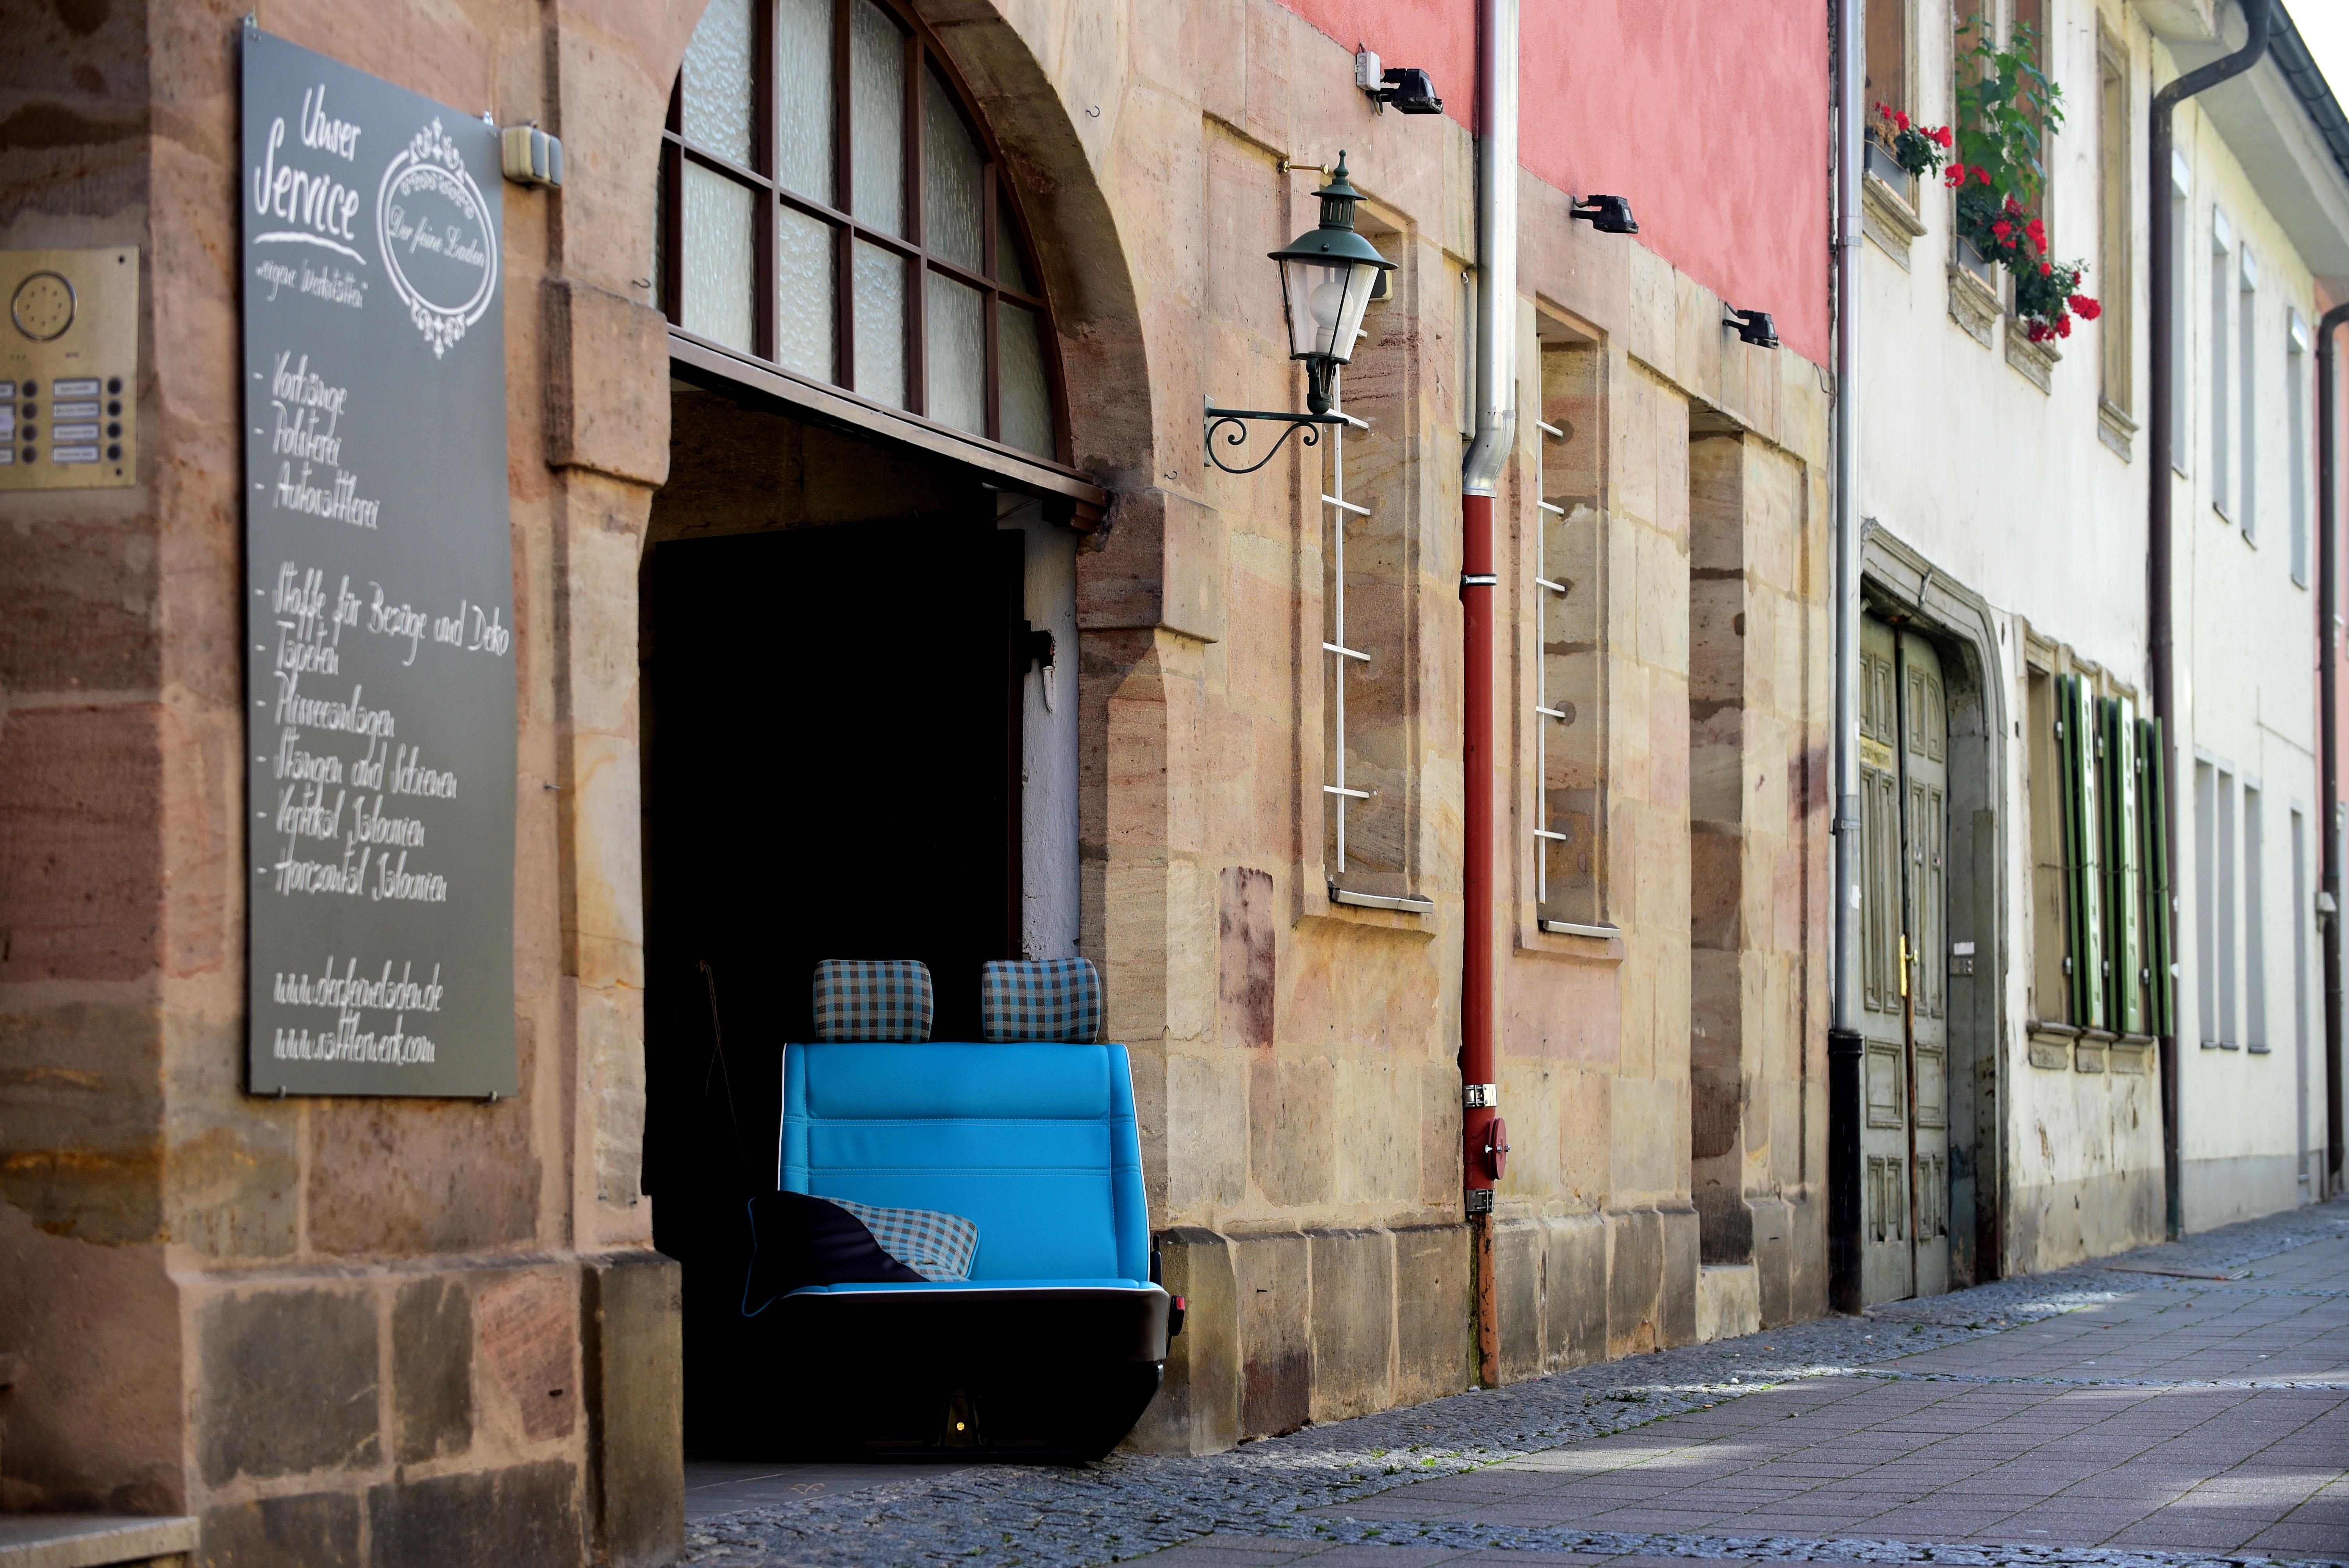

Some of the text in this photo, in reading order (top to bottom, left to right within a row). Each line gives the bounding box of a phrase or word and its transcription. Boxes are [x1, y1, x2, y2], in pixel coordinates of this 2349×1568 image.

[301, 83, 362, 162] Unser
[254, 117, 359, 241] Service
[390, 204, 485, 268] Der feine Laden
[273, 349, 348, 438] Vorhänge
[271, 400, 342, 467] Polsterei
[273, 460, 380, 530] Autosattlerei
[273, 561, 509, 666] Stoffe für Bezüge und Deko
[275, 620, 339, 679] Tapeten
[273, 670, 395, 764] Plisseeanlagen
[274, 725, 457, 804] Stangen und Schienen
[276, 780, 425, 848] Vertikal Jalousien
[274, 830, 447, 902] Horizontal Jalousien
[273, 954, 444, 1012] www.derfeineladen.de
[273, 1007, 436, 1066] www.sattlerwerk.com
